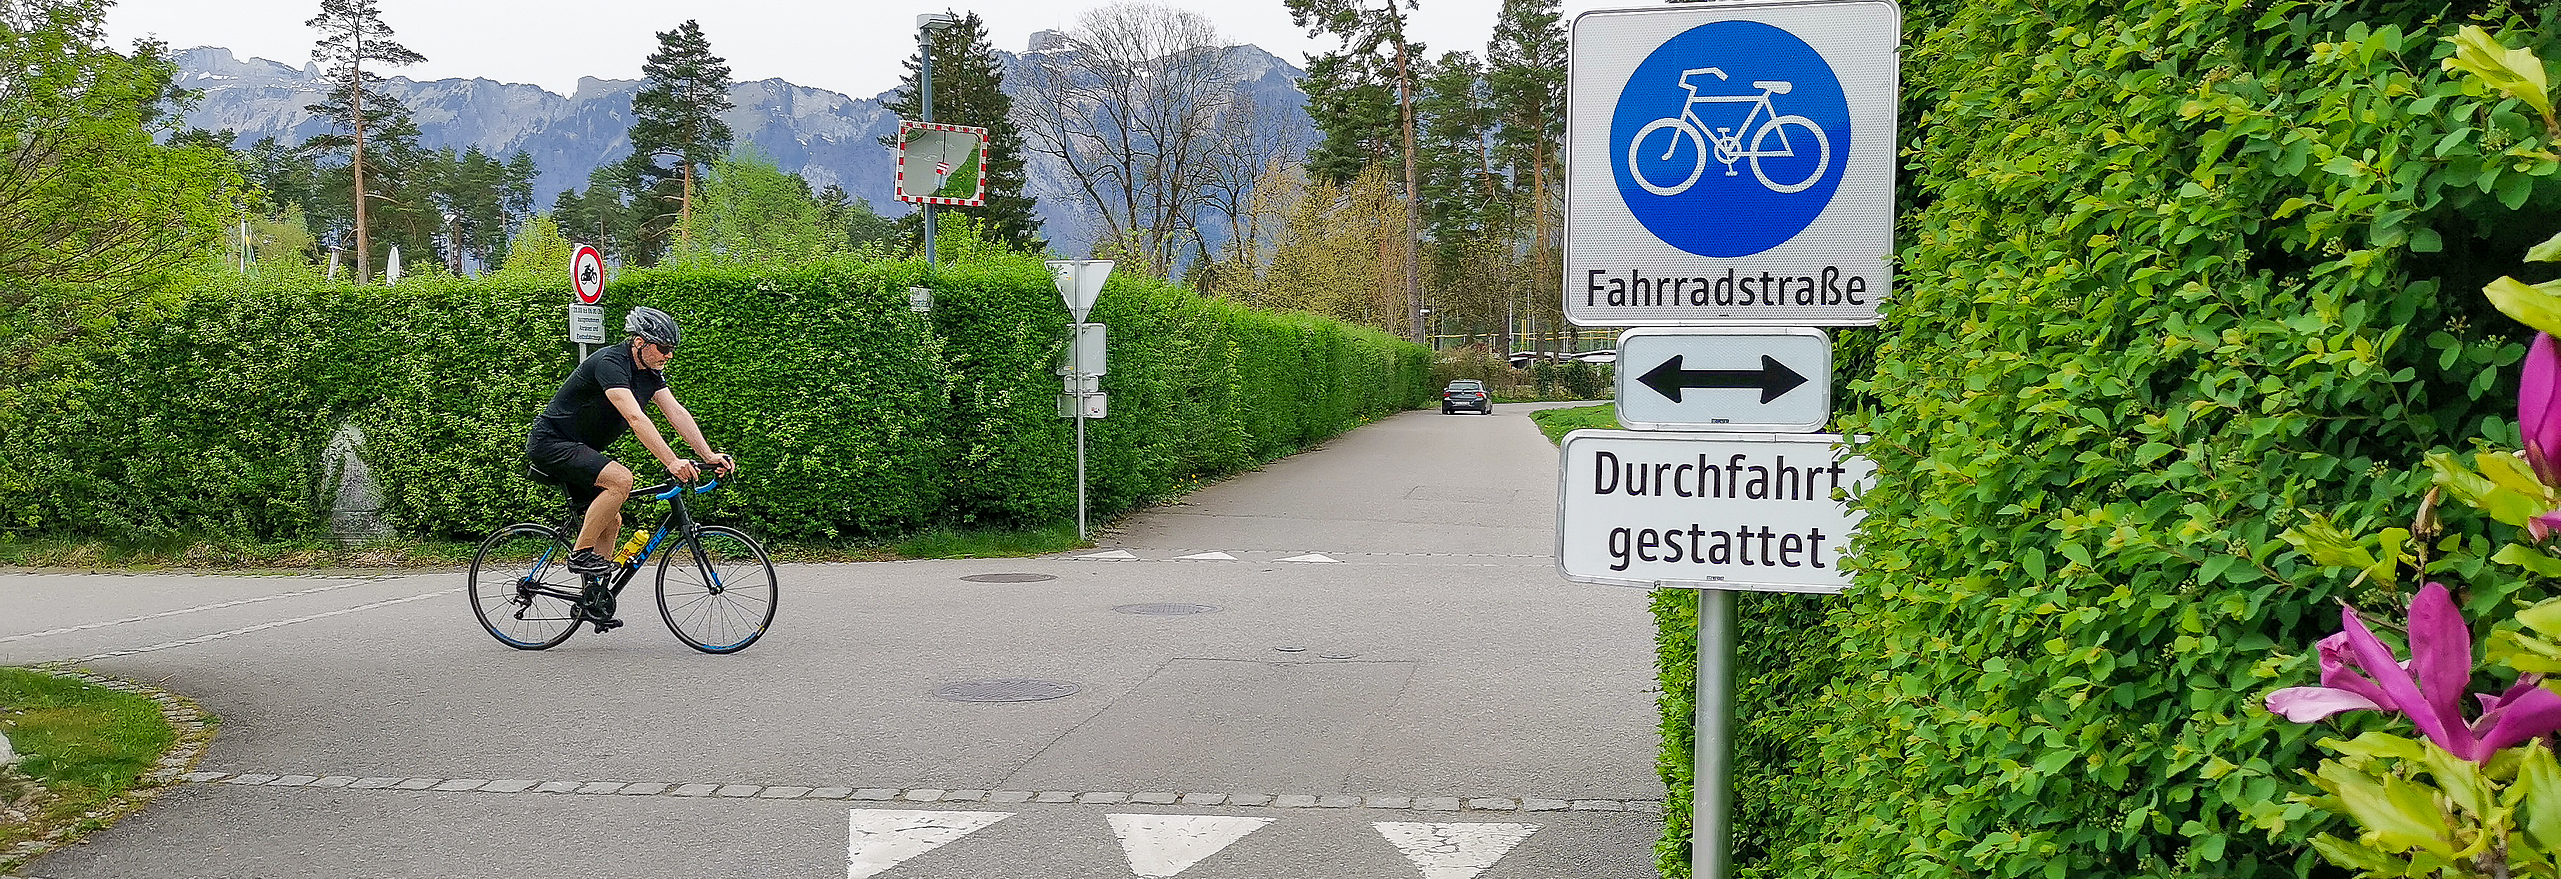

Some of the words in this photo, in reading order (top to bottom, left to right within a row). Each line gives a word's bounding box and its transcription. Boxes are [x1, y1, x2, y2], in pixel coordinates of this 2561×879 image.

[1587, 265, 1866, 308] Fahrradstraße
[1594, 451, 1846, 501] Durchfahrt
[1608, 523, 1826, 572] gestattet
